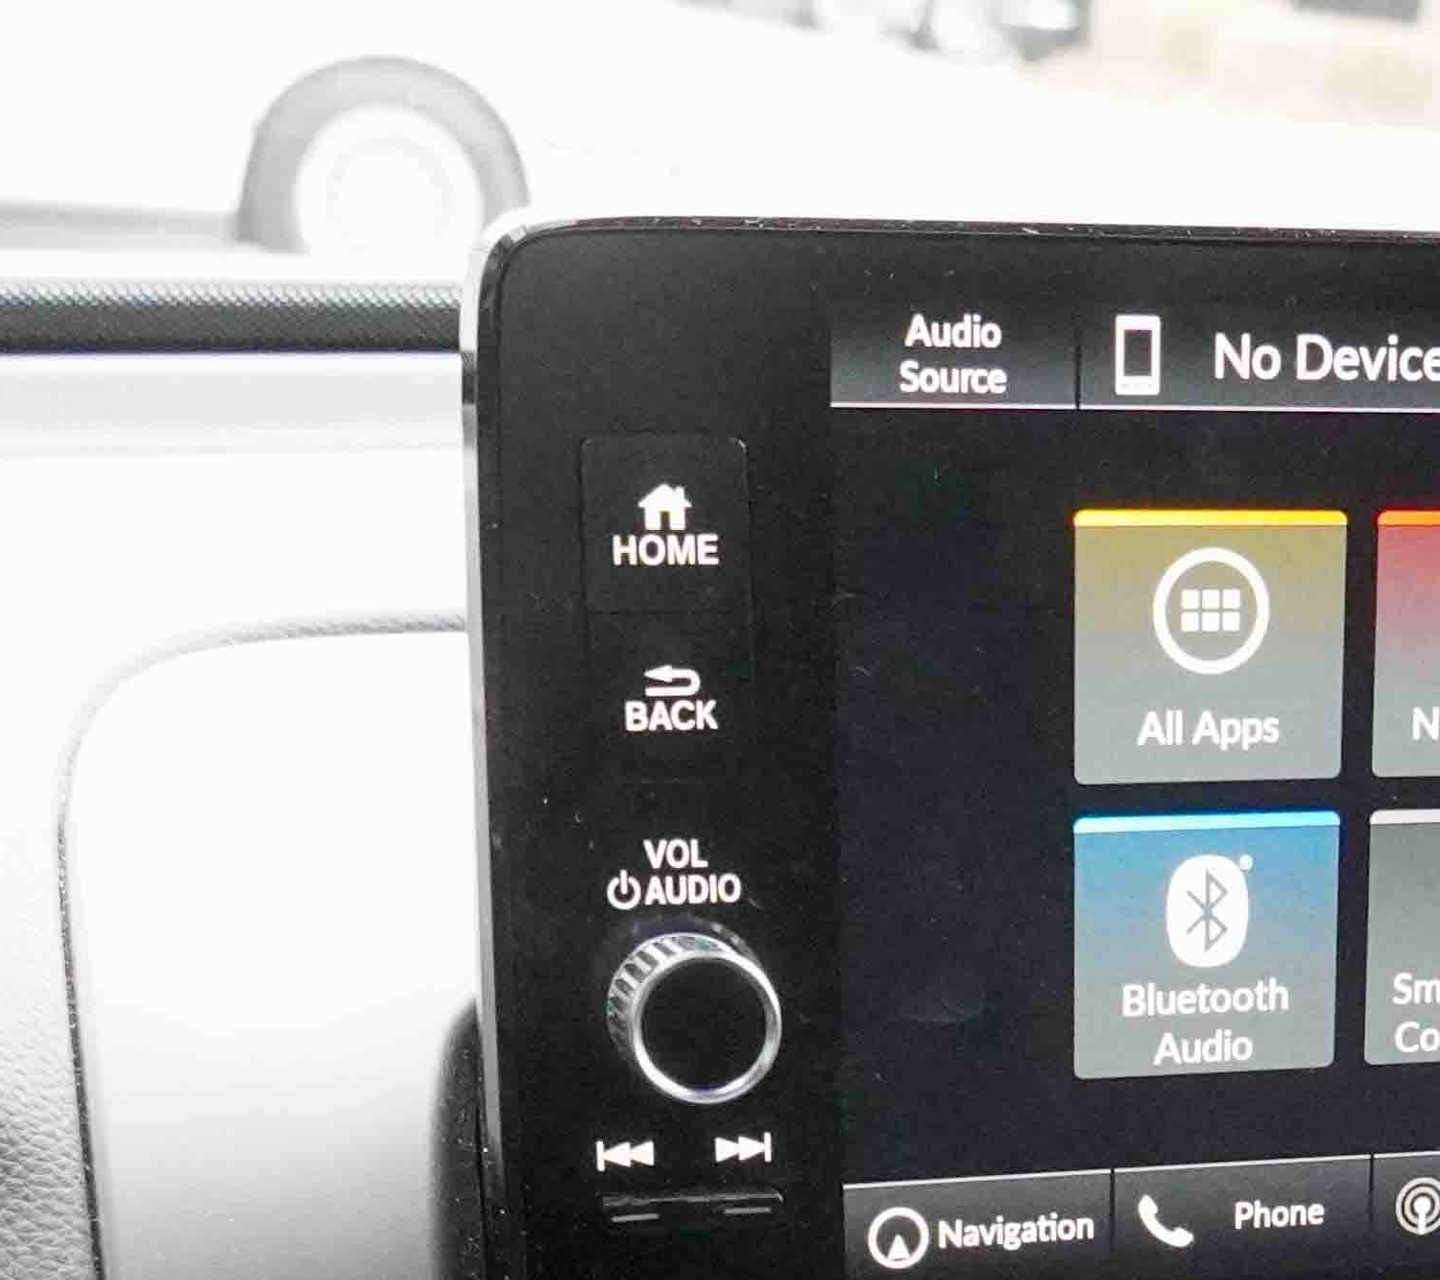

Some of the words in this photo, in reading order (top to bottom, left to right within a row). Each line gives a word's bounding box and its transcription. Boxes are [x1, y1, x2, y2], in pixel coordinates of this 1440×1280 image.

[905, 314, 1001, 350] Audio
[1214, 334, 1280, 380] No
[900, 362, 1007, 395] Source
[613, 535, 718, 566] HOME
[625, 700, 717, 732] BACK
[1137, 710, 1185, 746] All
[1193, 710, 1280, 750] Apps
[644, 840, 707, 869] VOL
[645, 874, 741, 906] AUDIO
[1122, 978, 1289, 1018] Bluetooth
[1154, 1030, 1254, 1065] Audio
[1234, 1198, 1325, 1229] Phone
[938, 1216, 1094, 1251] Navigation
